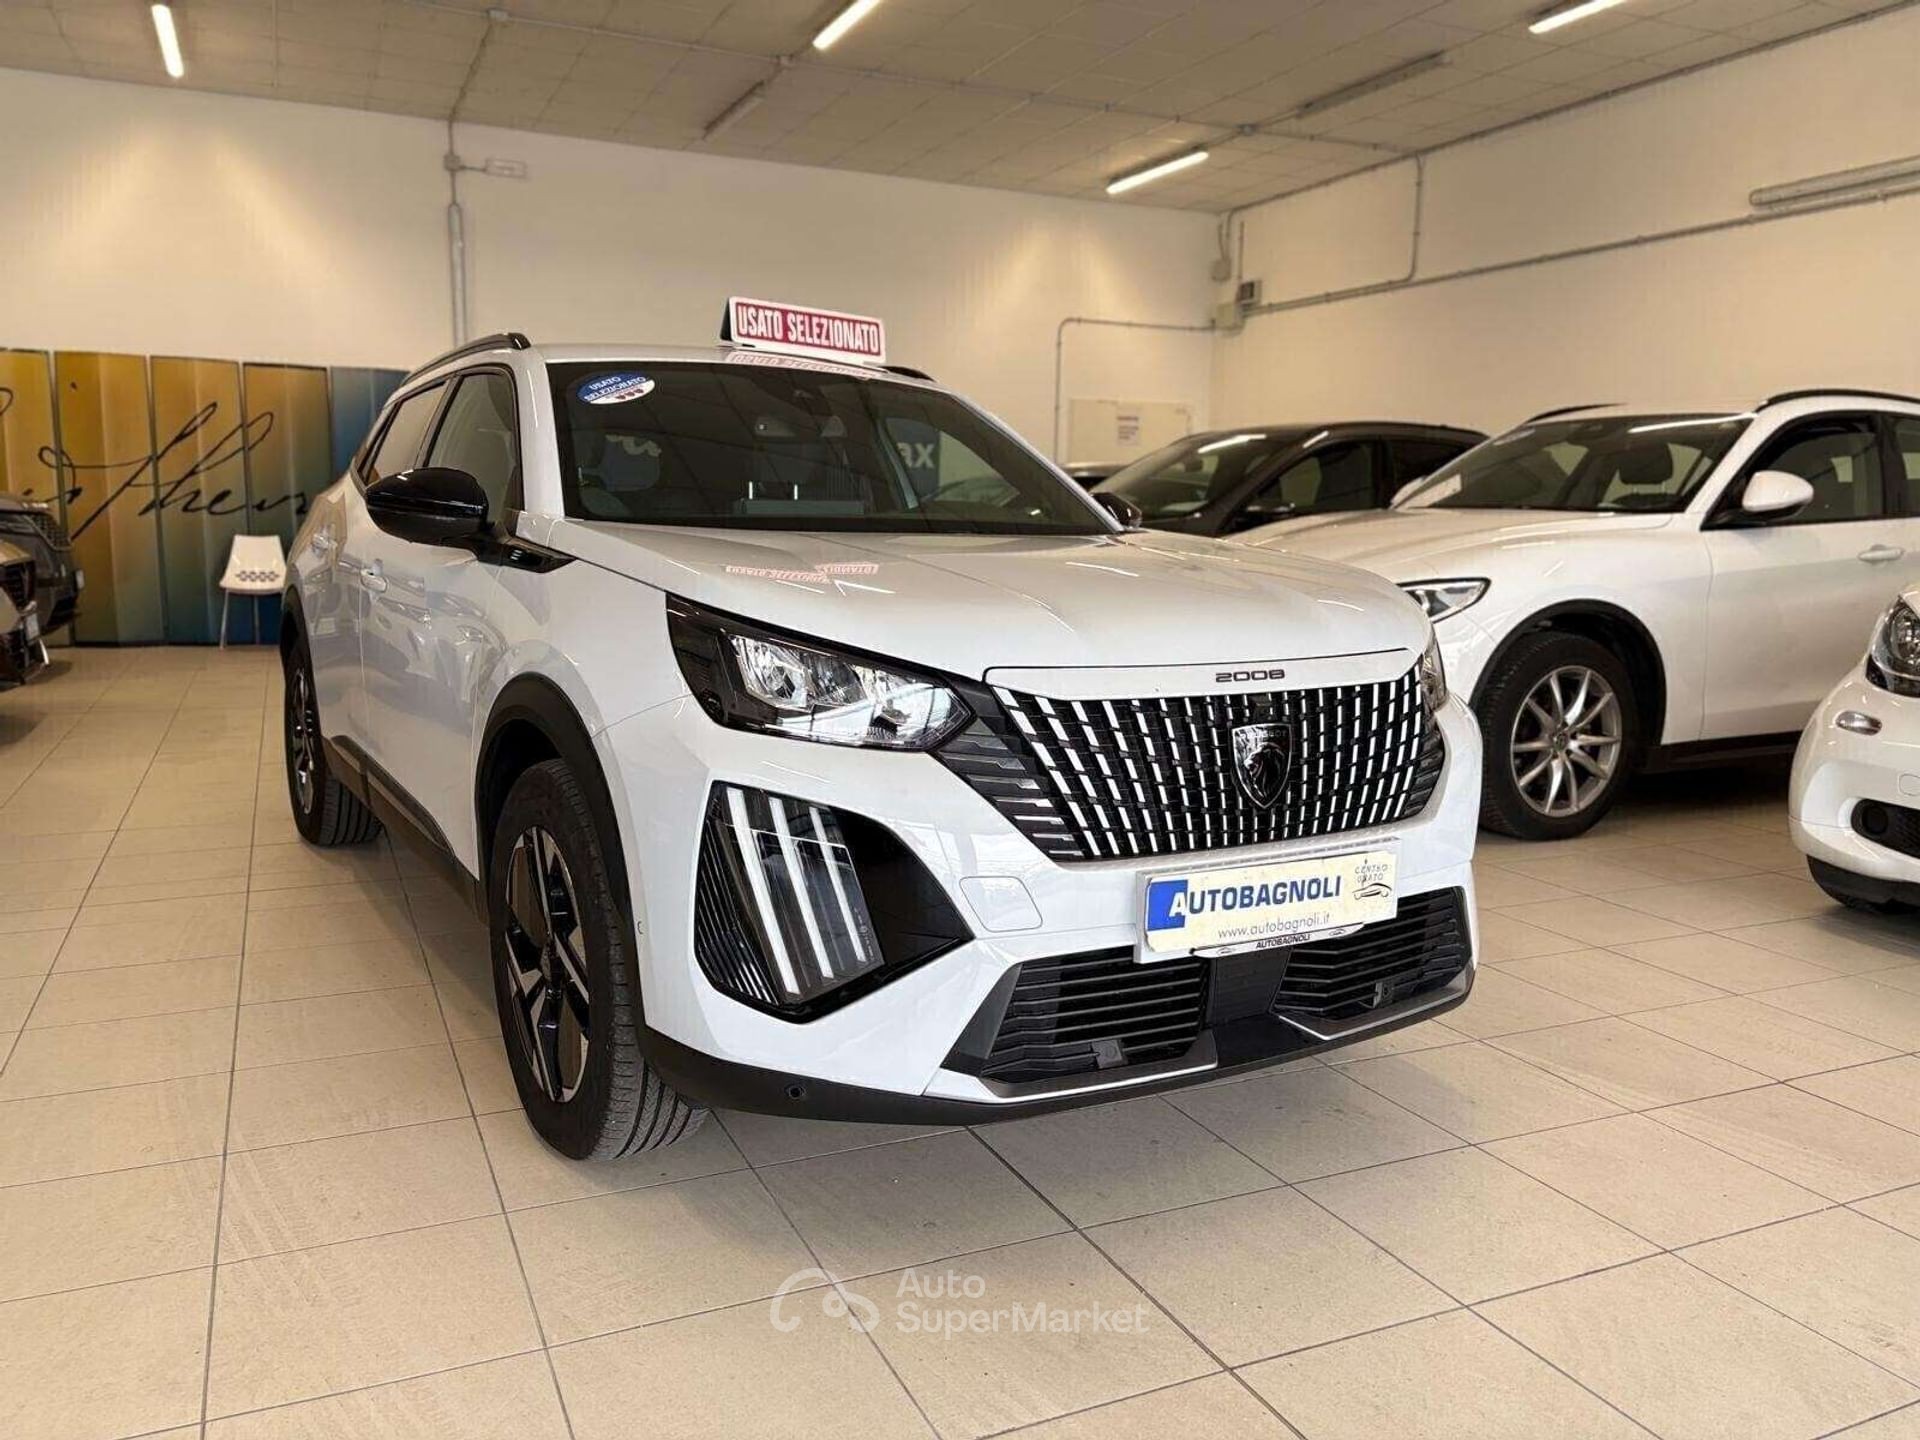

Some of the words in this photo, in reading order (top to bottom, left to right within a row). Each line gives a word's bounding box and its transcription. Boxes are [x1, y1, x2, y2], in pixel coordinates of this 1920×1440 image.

[737, 304, 784, 341] USATO
[787, 313, 879, 354] SELEZIONATO
[589, 376, 622, 391] USATO
[1215, 669, 1286, 683] 2008
[1168, 875, 1342, 918] AUTOBAGNOLI
[1218, 912, 1331, 939] www.autobagnoli.it
[1255, 933, 1312, 950] AUTOBAGNOLI
